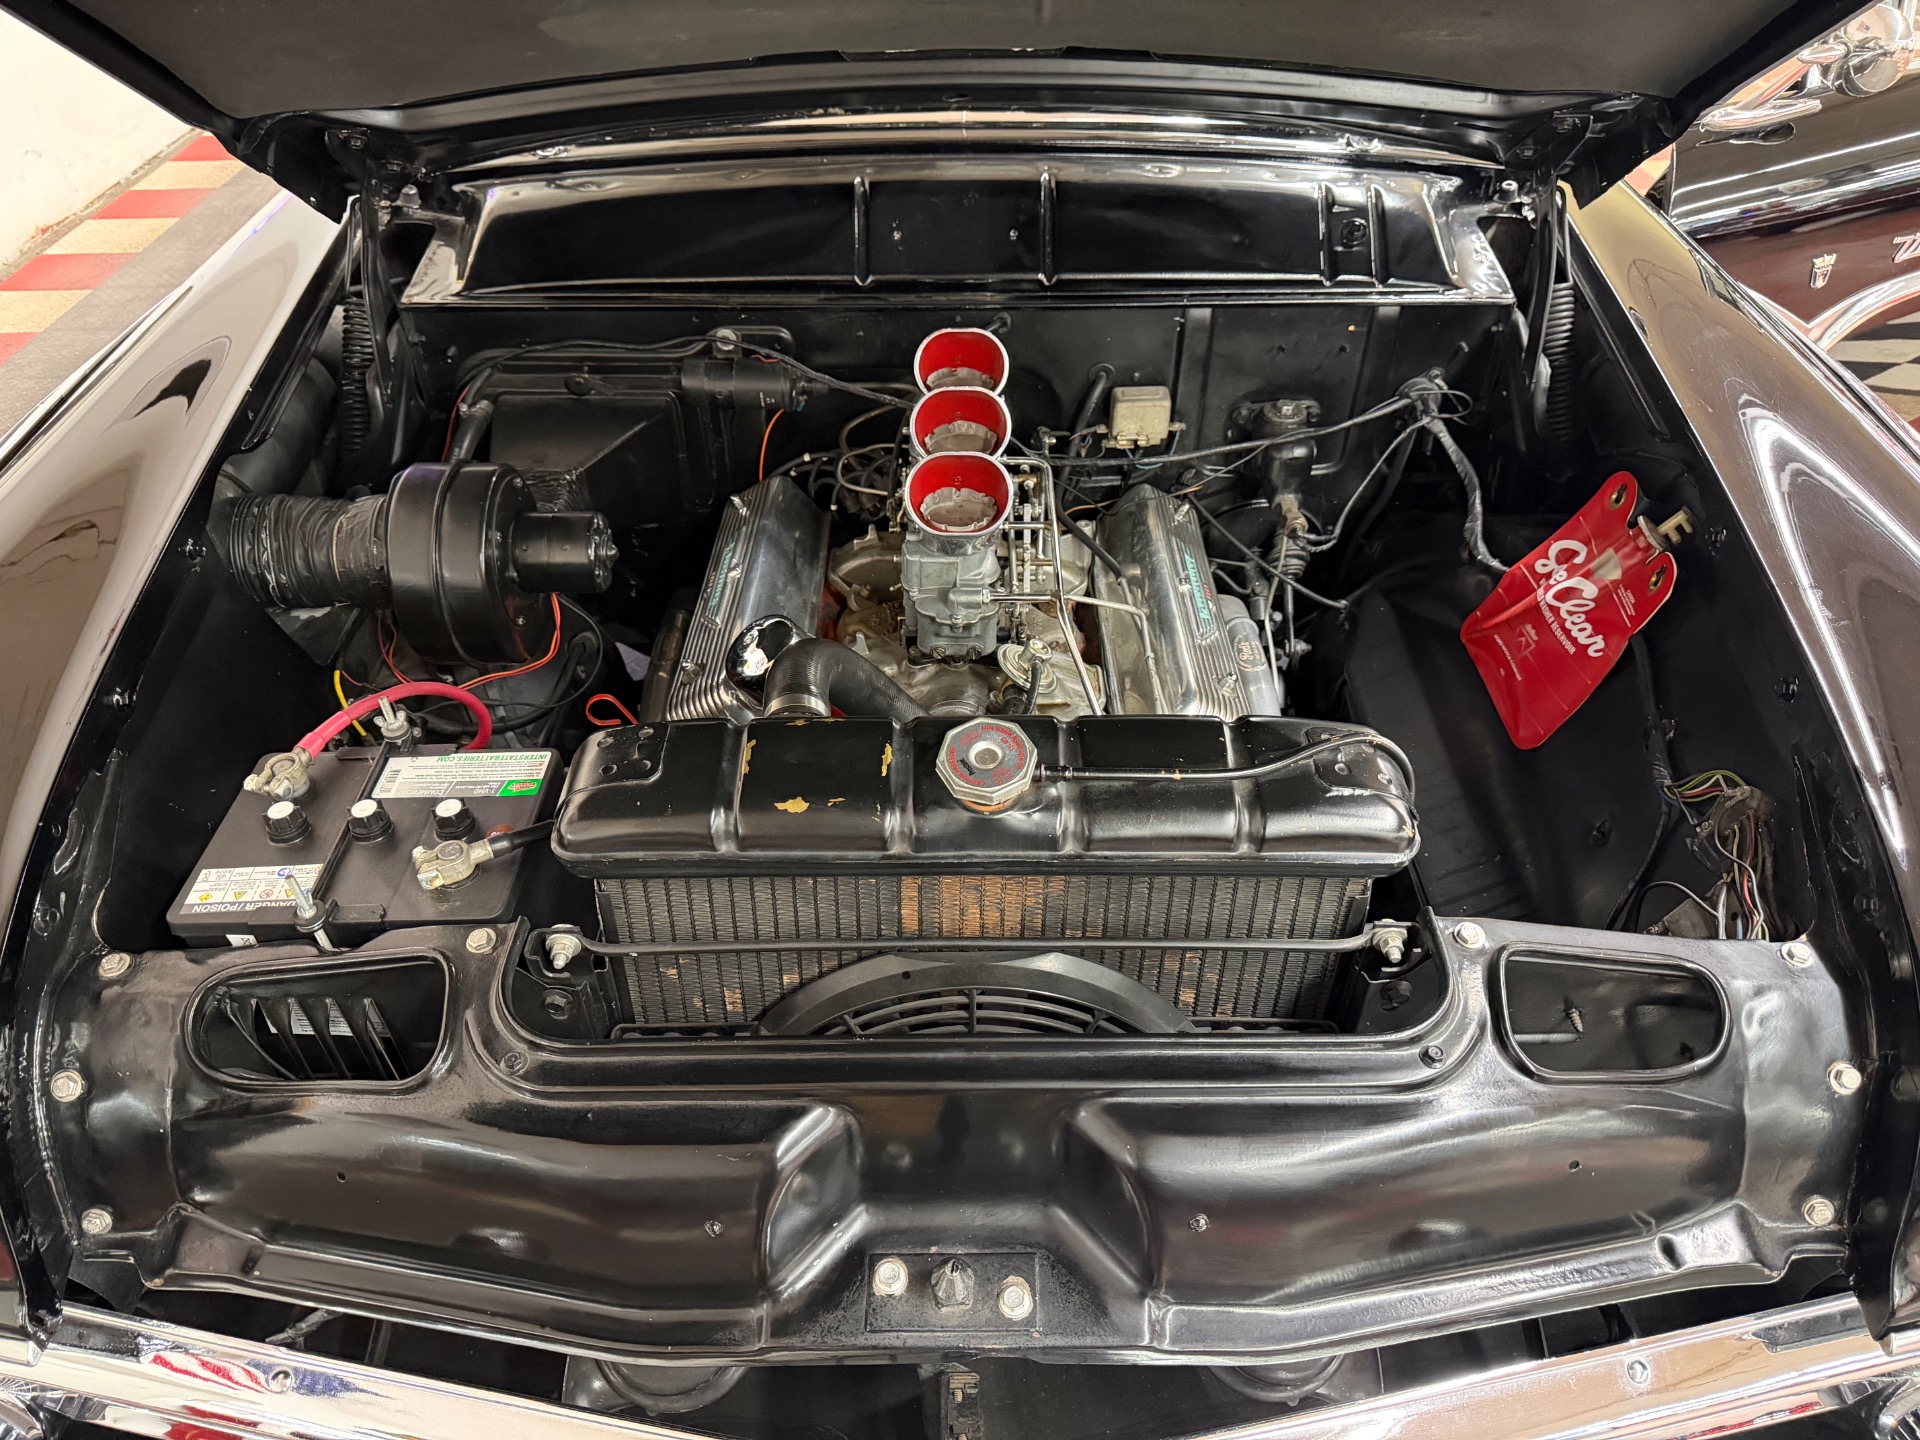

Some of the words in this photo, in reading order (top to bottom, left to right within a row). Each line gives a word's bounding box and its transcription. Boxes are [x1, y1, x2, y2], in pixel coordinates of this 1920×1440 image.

[1538, 598, 1555, 625] WASHER
[1550, 619, 1577, 656] RESERVOIR
[1545, 576, 1605, 658] Clean
[191, 903, 239, 913] POISON
